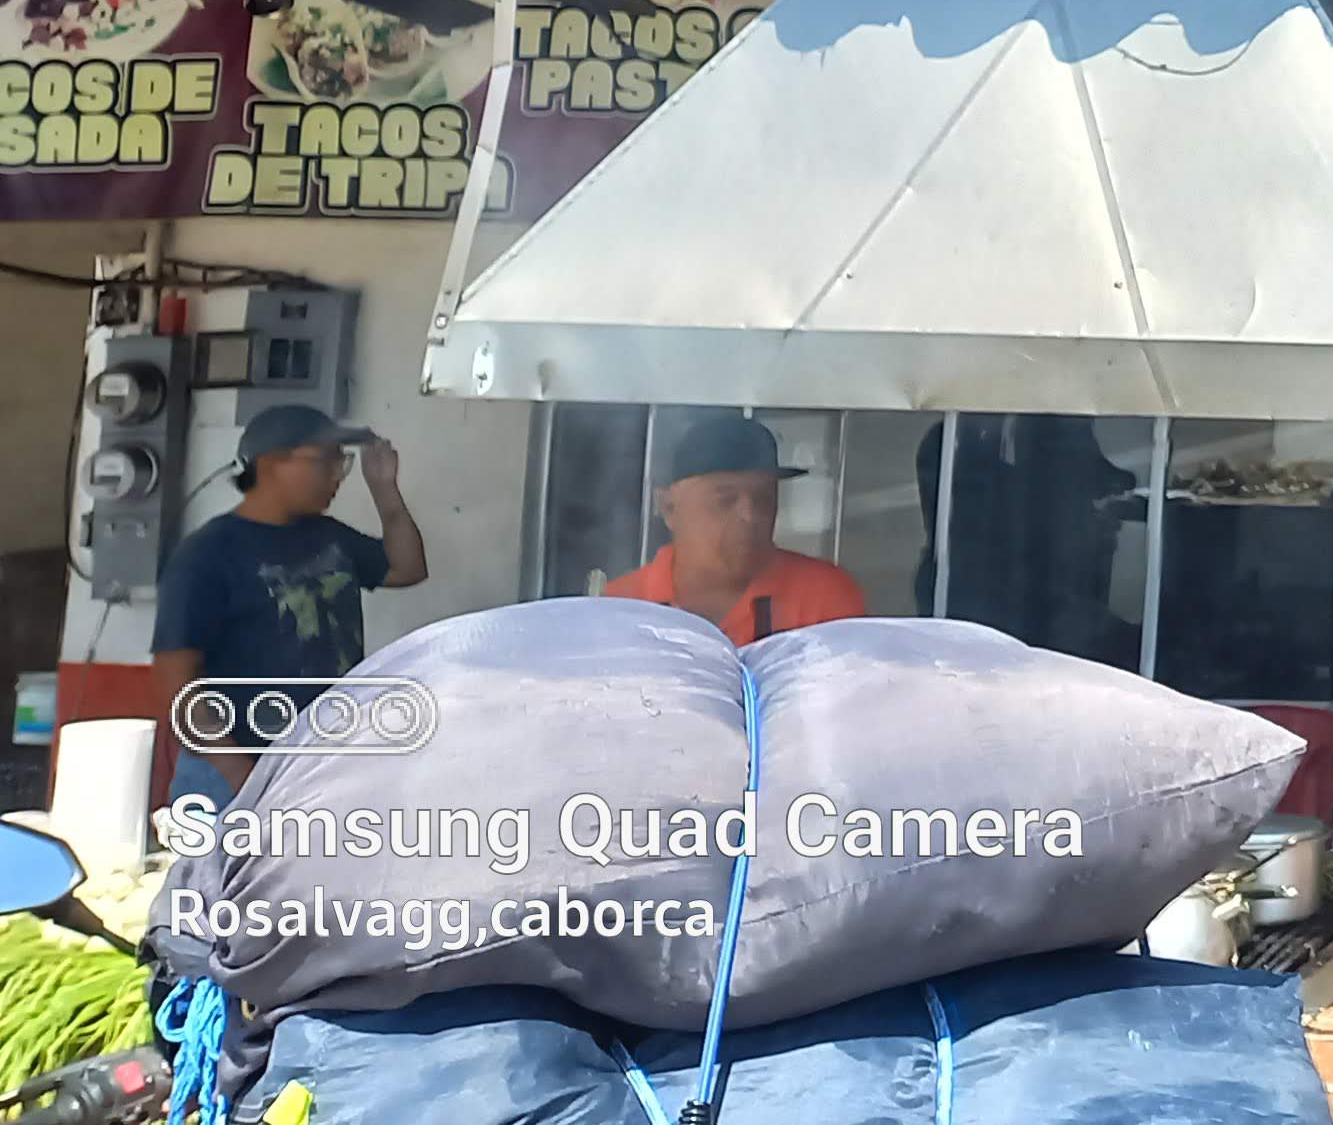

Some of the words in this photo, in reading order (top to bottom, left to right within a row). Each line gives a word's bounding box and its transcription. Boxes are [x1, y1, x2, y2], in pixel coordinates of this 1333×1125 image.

[131, 61, 217, 113] DE
[528, 58, 698, 111] PAST
[252, 104, 464, 158] TACOS
[207, 152, 302, 206] DE
